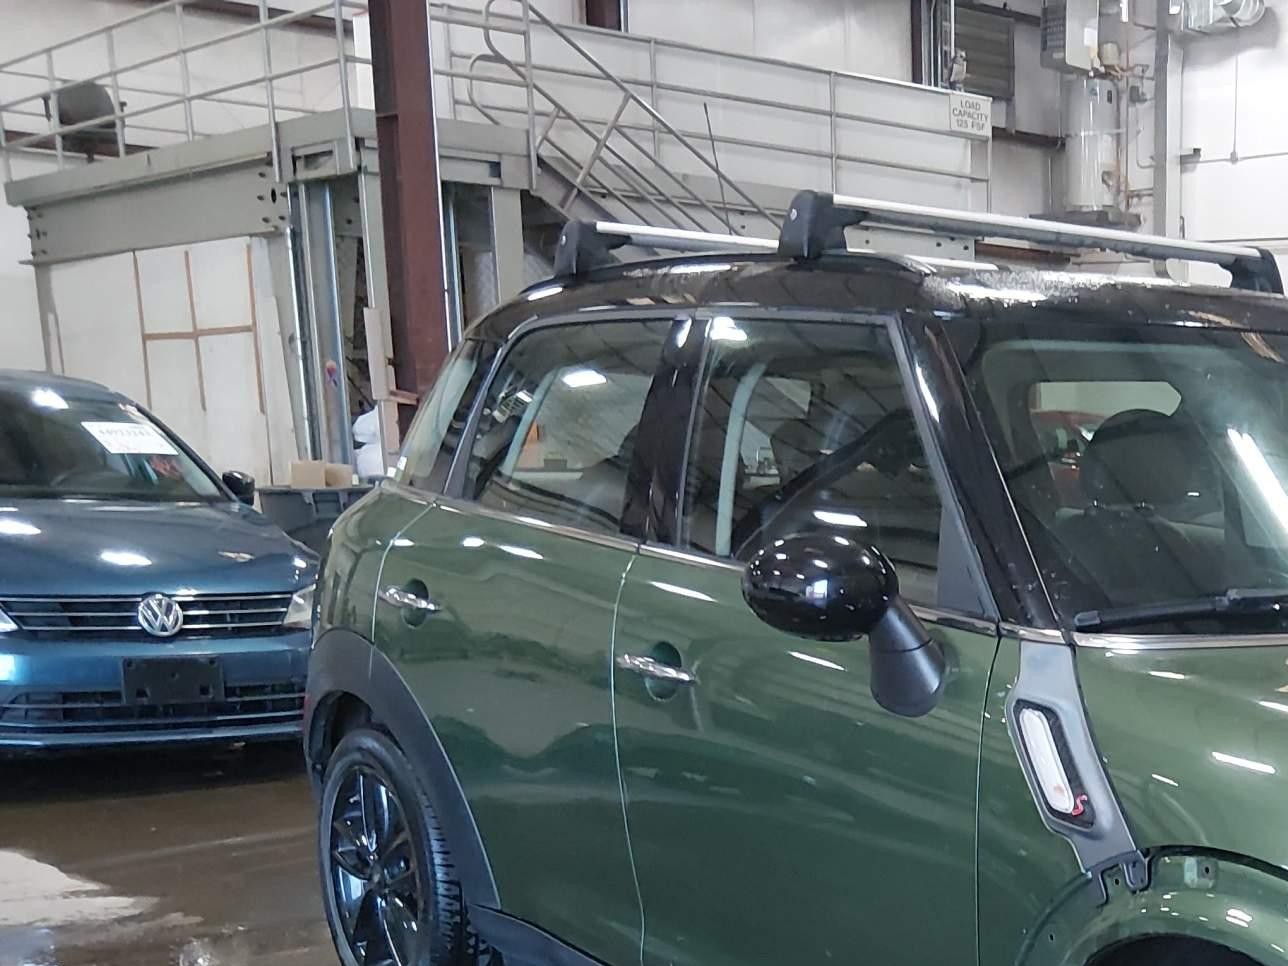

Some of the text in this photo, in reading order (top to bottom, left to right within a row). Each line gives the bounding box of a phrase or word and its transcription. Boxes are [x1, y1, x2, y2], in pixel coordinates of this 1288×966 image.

[960, 99, 981, 111] LOAD
[952, 107, 988, 121] CAPACITY
[1071, 794, 1088, 817] S
